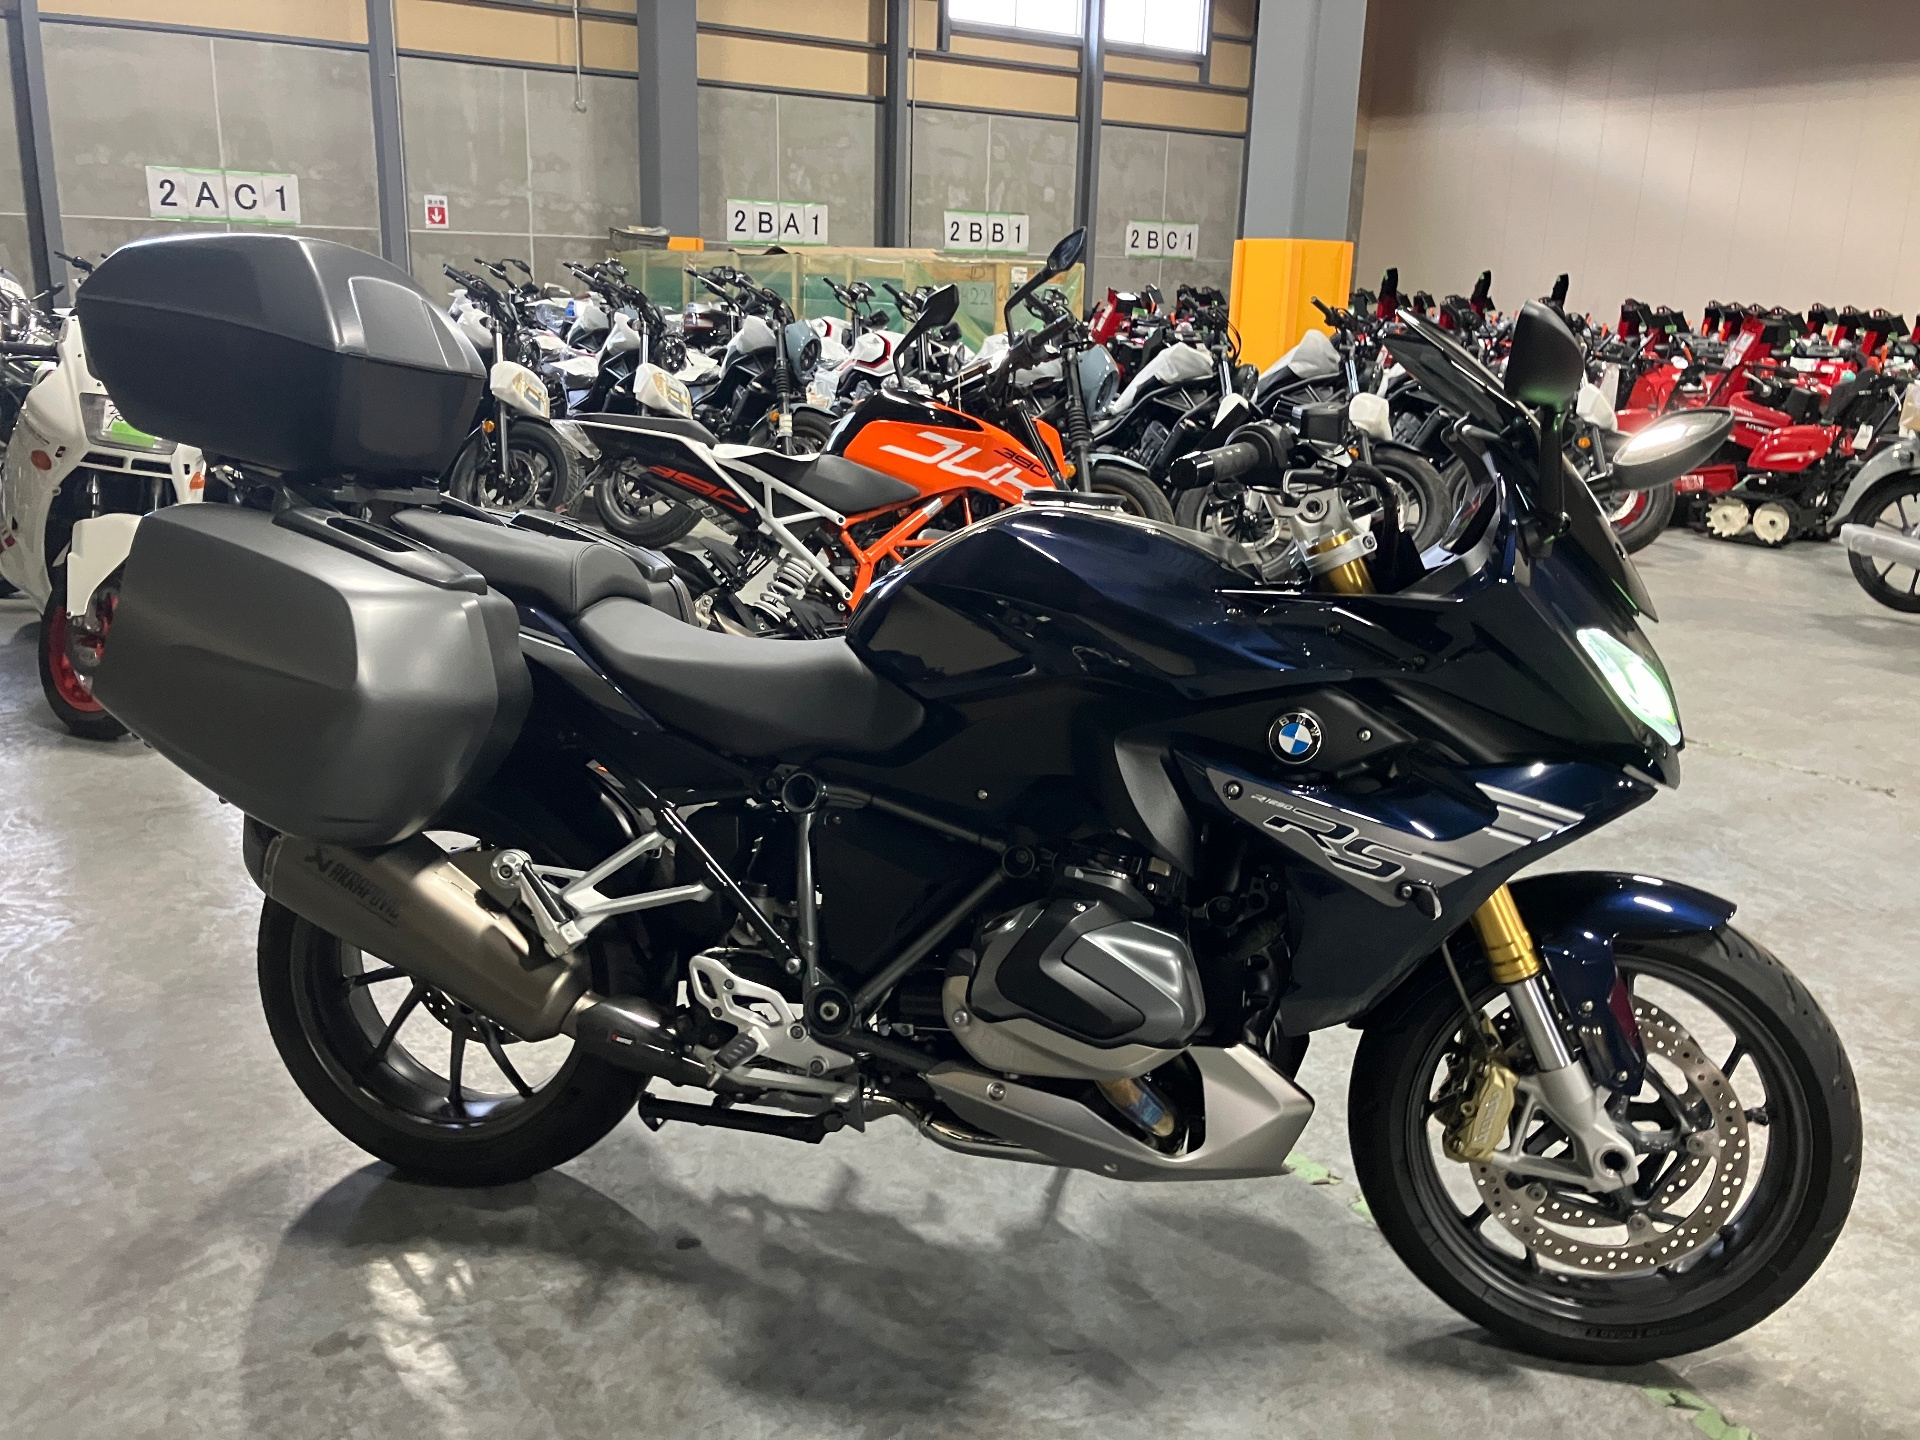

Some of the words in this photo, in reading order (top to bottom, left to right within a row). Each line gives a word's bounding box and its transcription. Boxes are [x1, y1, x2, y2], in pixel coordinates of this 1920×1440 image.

[878, 431, 1056, 491] DUK
[1279, 714, 1320, 737] BMW
[1263, 808, 1406, 882] RS
